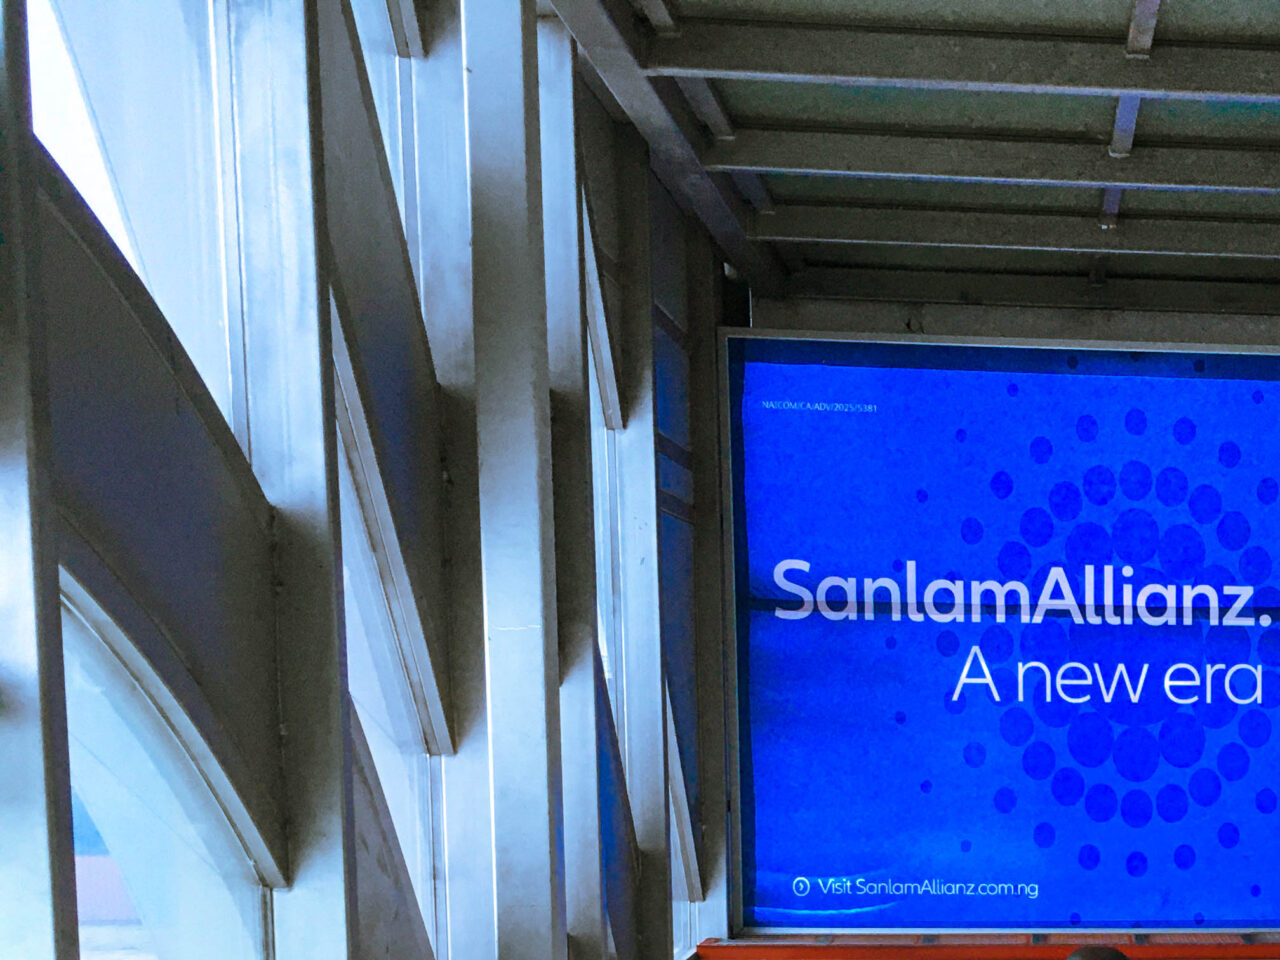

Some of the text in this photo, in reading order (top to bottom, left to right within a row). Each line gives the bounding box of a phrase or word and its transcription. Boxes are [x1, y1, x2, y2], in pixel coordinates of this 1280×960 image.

[772, 558, 1272, 627] SanlamAllianz.
[951, 645, 1002, 702] A
[1016, 660, 1149, 704] new
[1163, 662, 1263, 706] era
[817, 878, 1039, 897] Visit SanlamAllianz.com.ng
